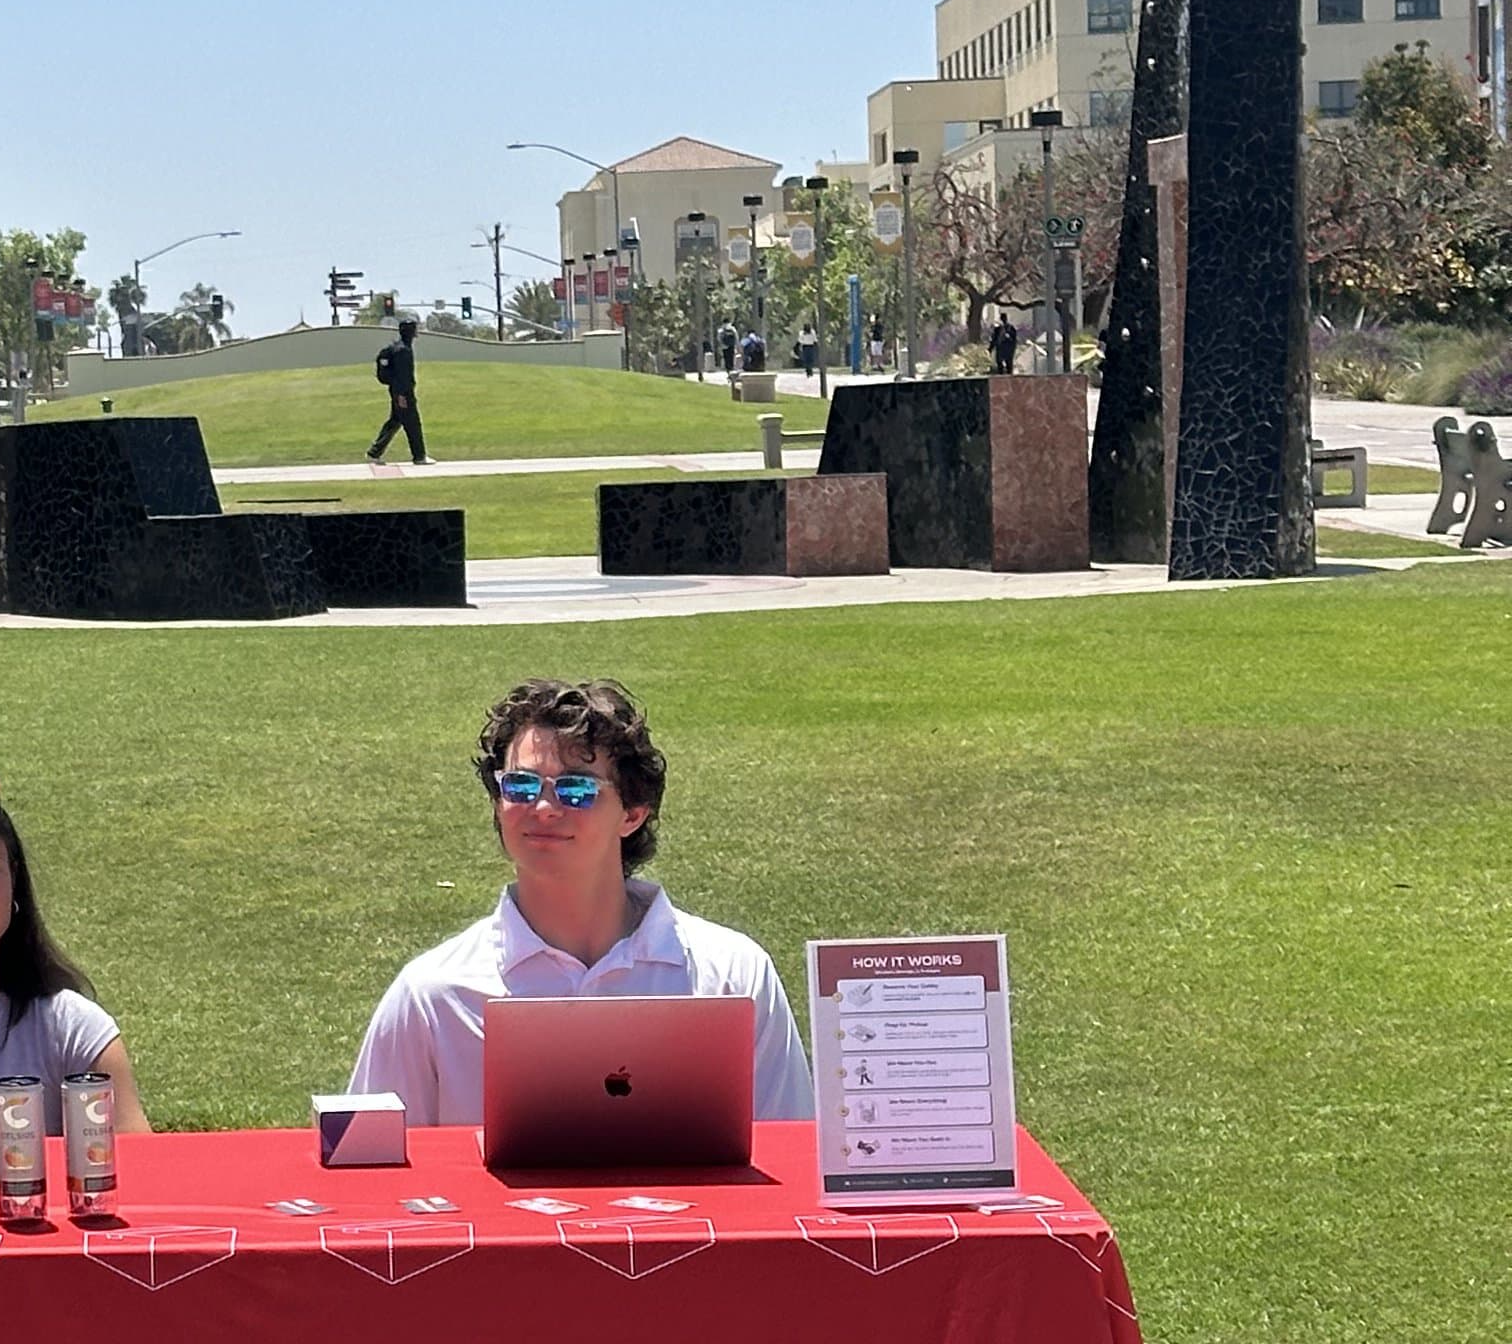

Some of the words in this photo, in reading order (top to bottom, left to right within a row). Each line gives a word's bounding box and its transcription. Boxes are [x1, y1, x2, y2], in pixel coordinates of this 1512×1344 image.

[852, 956, 887, 968] HOW
[891, 956, 905, 967] IT
[908, 954, 963, 967] WORKS
